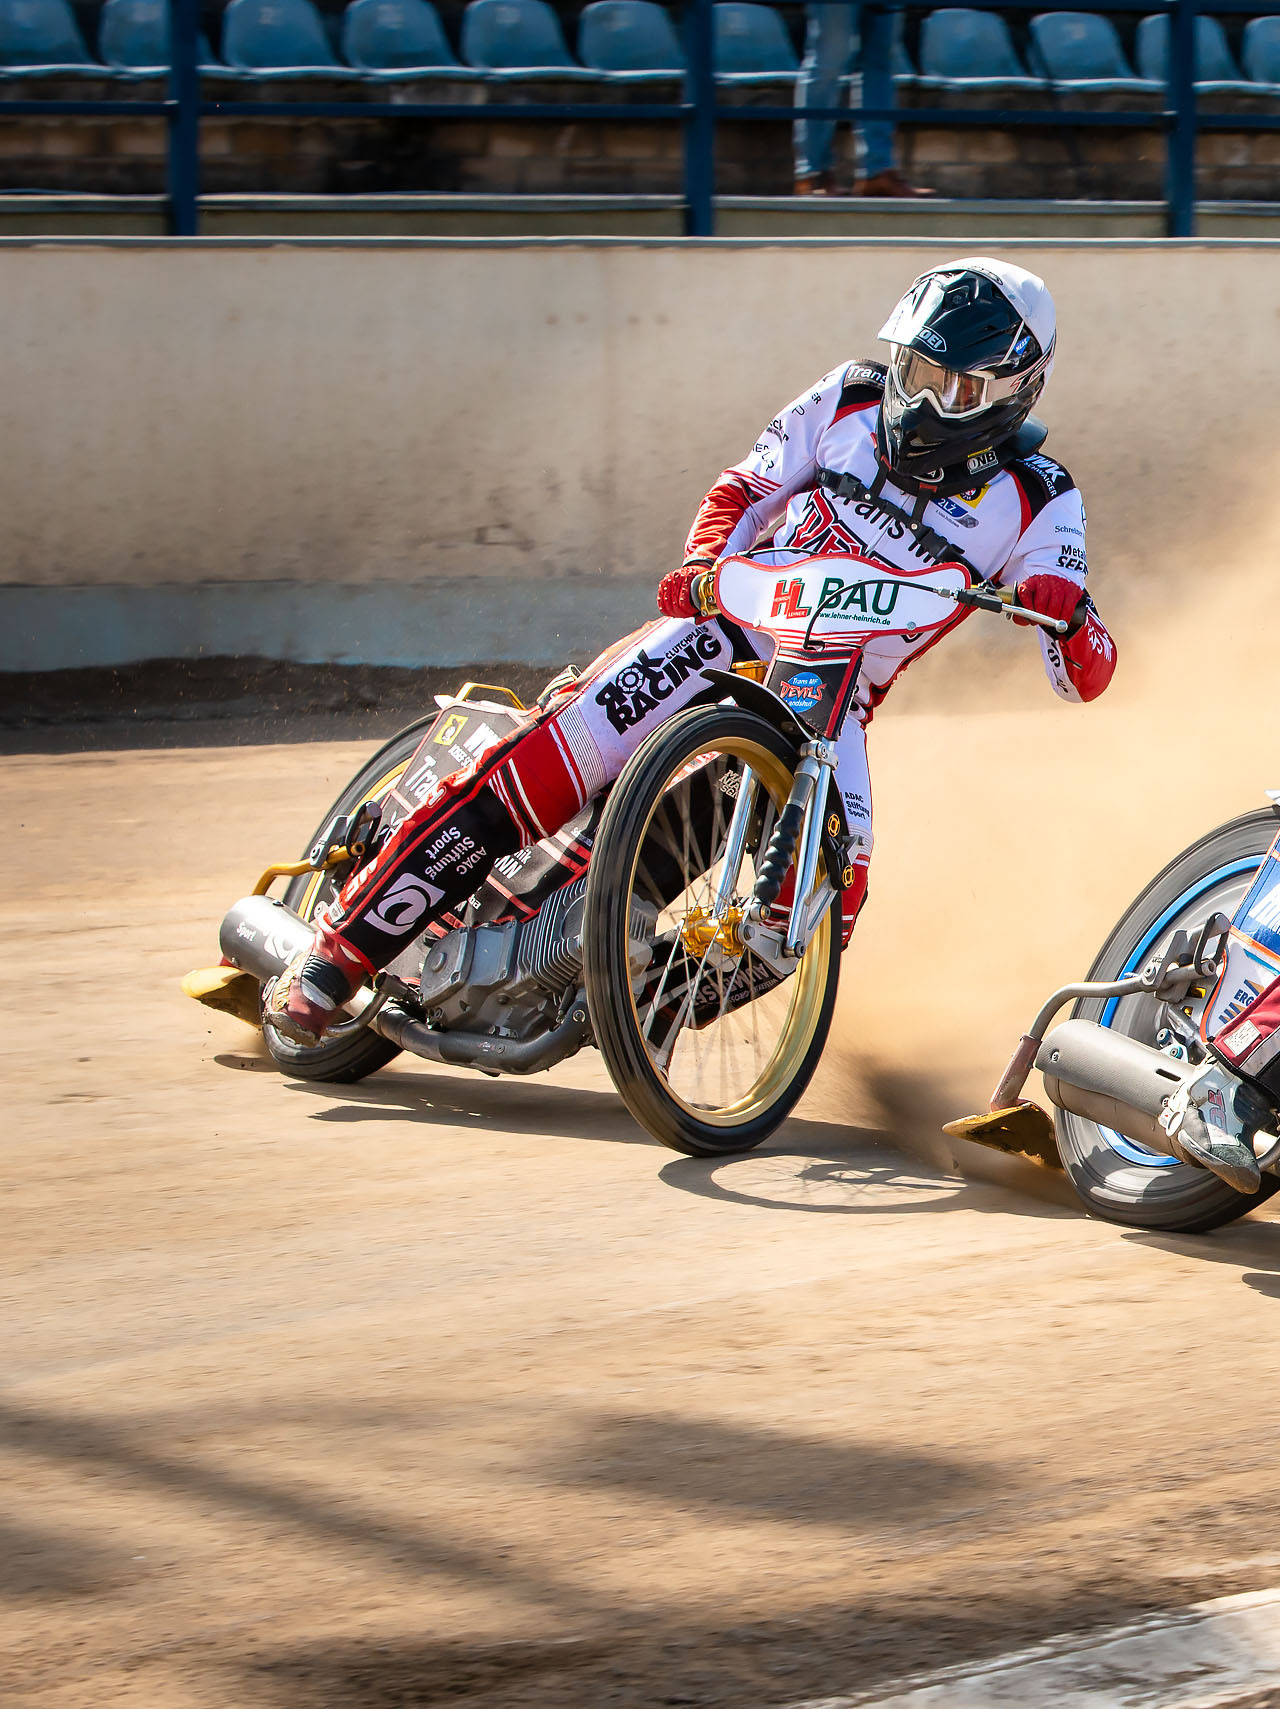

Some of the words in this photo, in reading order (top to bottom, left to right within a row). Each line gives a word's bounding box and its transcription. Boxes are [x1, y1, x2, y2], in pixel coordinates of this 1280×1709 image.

[818, 577, 900, 616] BAU
[817, 611, 891, 627] ww.lehner-heinrich.de
[606, 633, 722, 736] RACING
[780, 681, 828, 702] DEVILS
[424, 836, 476, 880] Stiftung
[425, 826, 461, 859] Sport
[455, 846, 488, 876] ADAC
[1233, 988, 1256, 1008] ERG
